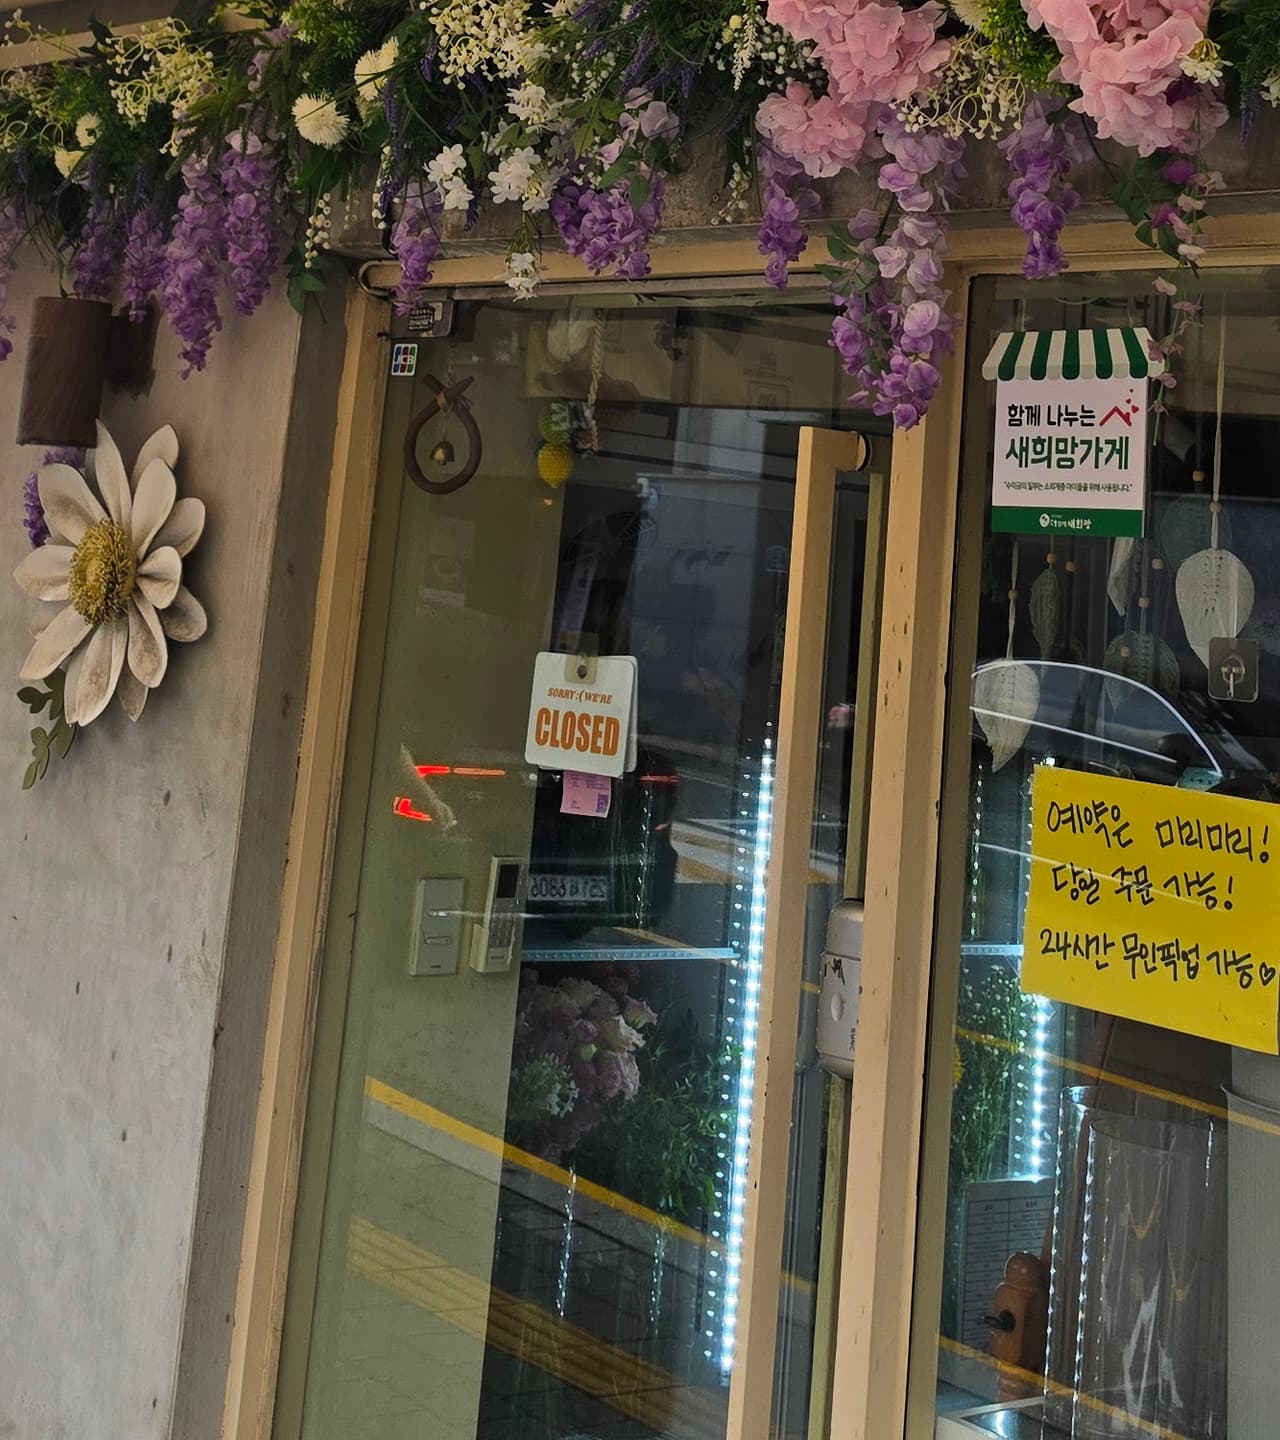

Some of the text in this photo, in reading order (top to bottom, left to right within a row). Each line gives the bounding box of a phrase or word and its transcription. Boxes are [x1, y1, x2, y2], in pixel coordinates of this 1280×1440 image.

[1007, 404, 1096, 427] 함께 나누는
[1005, 436, 1130, 470] 새희망가게
[535, 707, 620, 756] CLOSED
[1047, 800, 1134, 849] 예약은
[1051, 862, 1233, 910] 당일 주문 가능!
[1040, 928, 1116, 971] 24시간
[1122, 933, 1201, 982] 무인픽업
